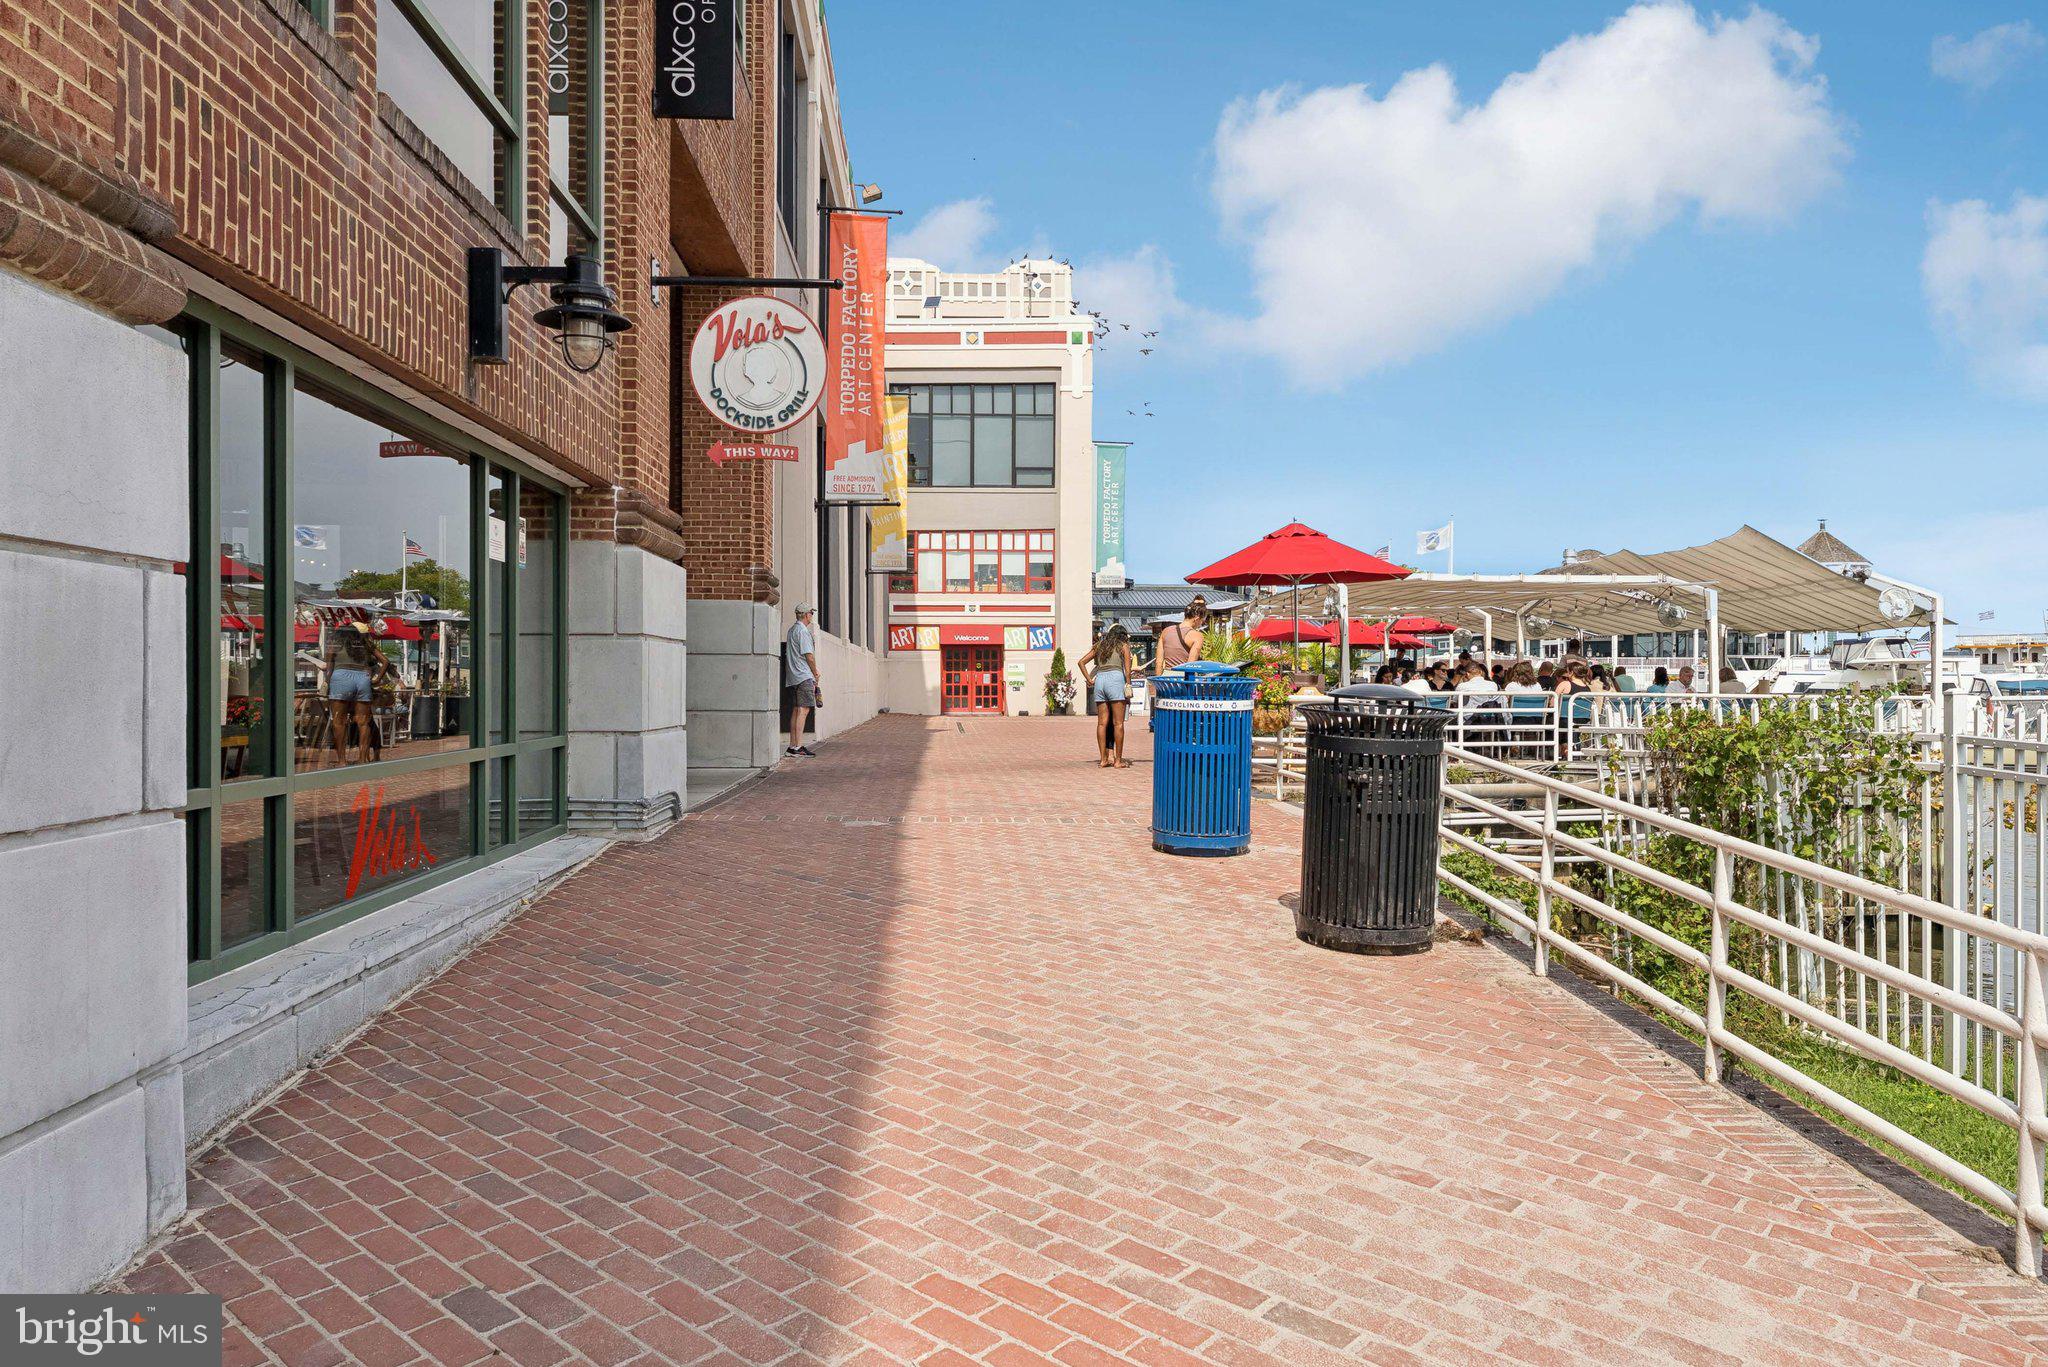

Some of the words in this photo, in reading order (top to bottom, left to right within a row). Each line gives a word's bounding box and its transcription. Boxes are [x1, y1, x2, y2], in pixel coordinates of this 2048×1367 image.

[701, 0, 716, 23] O
[664, 0, 696, 97] alxco
[841, 244, 858, 326] FACTORY
[708, 310, 807, 363] Vola's
[859, 292, 874, 371] CENTER
[840, 333, 856, 415] TORPEDO
[710, 387, 775, 429] DOCKSIDE
[778, 388, 809, 422] GRILL
[859, 381, 872, 416] ART
[724, 447, 756, 458] THIS
[761, 447, 795, 459] WAY!
[833, 484, 856, 493] SINCE
[858, 483, 876, 493] 1974
[1103, 459, 1112, 500] FACTORY
[1111, 482, 1119, 523] CENTER
[1103, 502, 1111, 544] TORPEDO
[1111, 525, 1119, 544] ART
[890, 626, 915, 649] ART
[917, 626, 939, 648] ART
[1005, 626, 1027, 648] ART
[1029, 626, 1054, 650] ART
[1162, 701, 1200, 709] RECYCLING
[344, 783, 437, 900] Vola's
